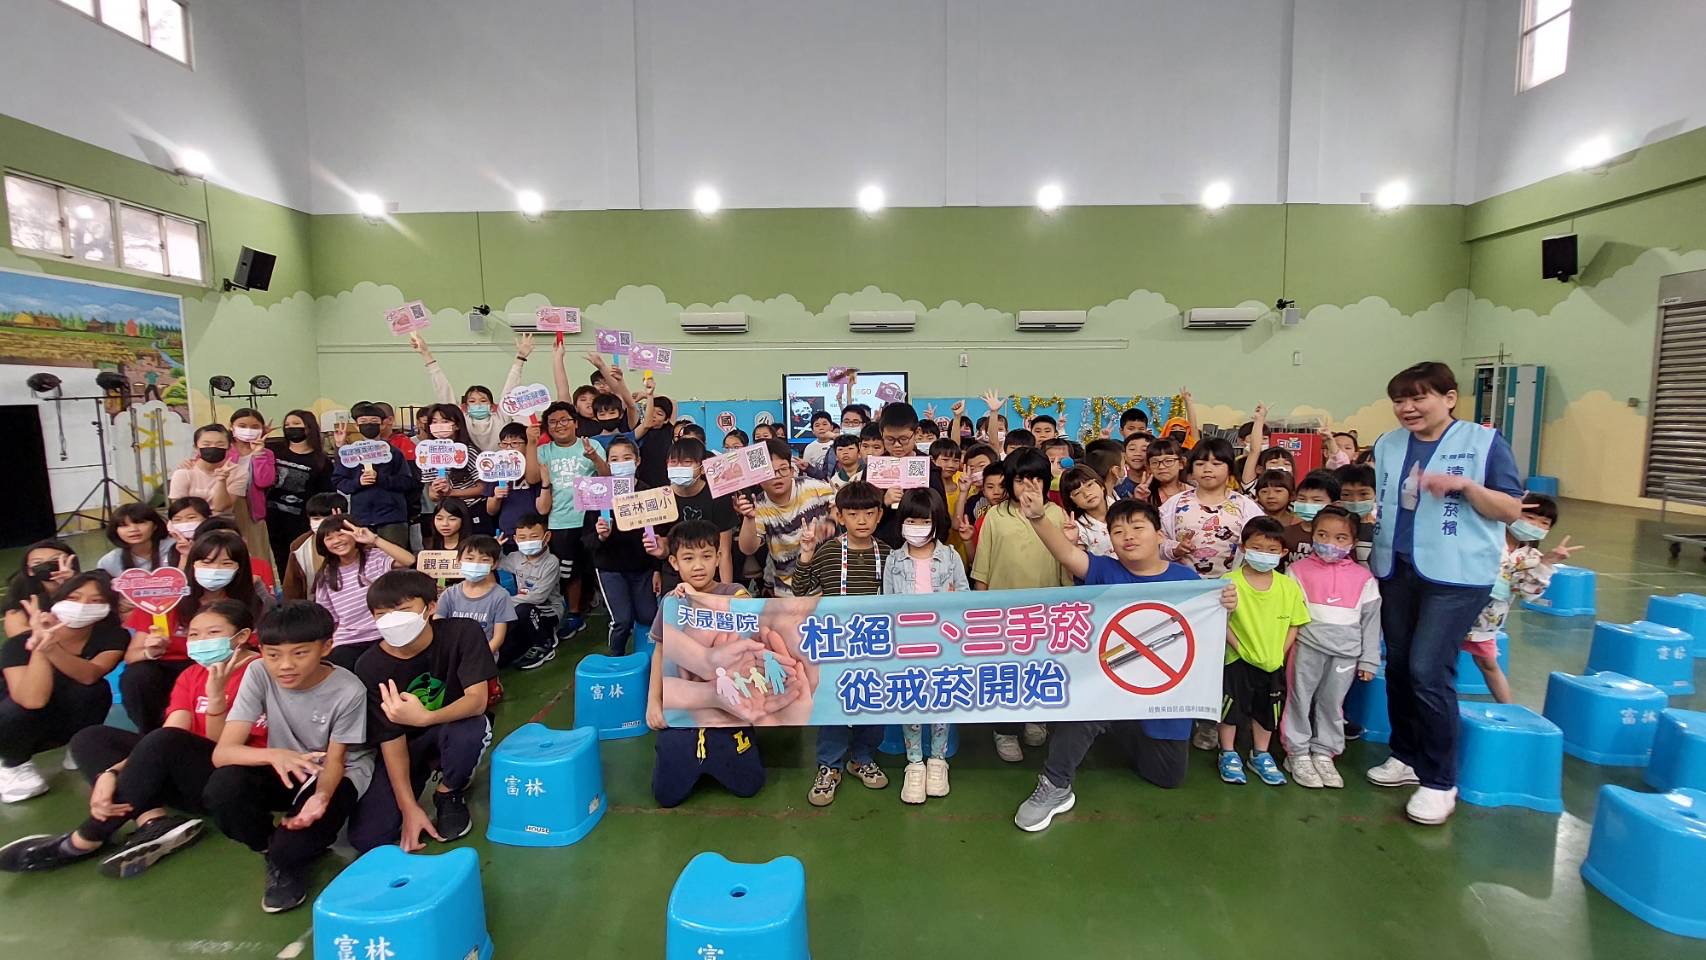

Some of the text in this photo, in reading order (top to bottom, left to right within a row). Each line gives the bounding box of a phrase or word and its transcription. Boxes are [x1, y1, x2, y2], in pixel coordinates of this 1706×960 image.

[617, 495, 673, 518] 富林國小
[677, 606, 760, 633] 天晟醫院
[801, 603, 1092, 661] 杜絕二、三手菸
[590, 683, 625, 701] 富林
[838, 663, 1067, 711] 從戒菸開始
[504, 774, 548, 797] 富林
